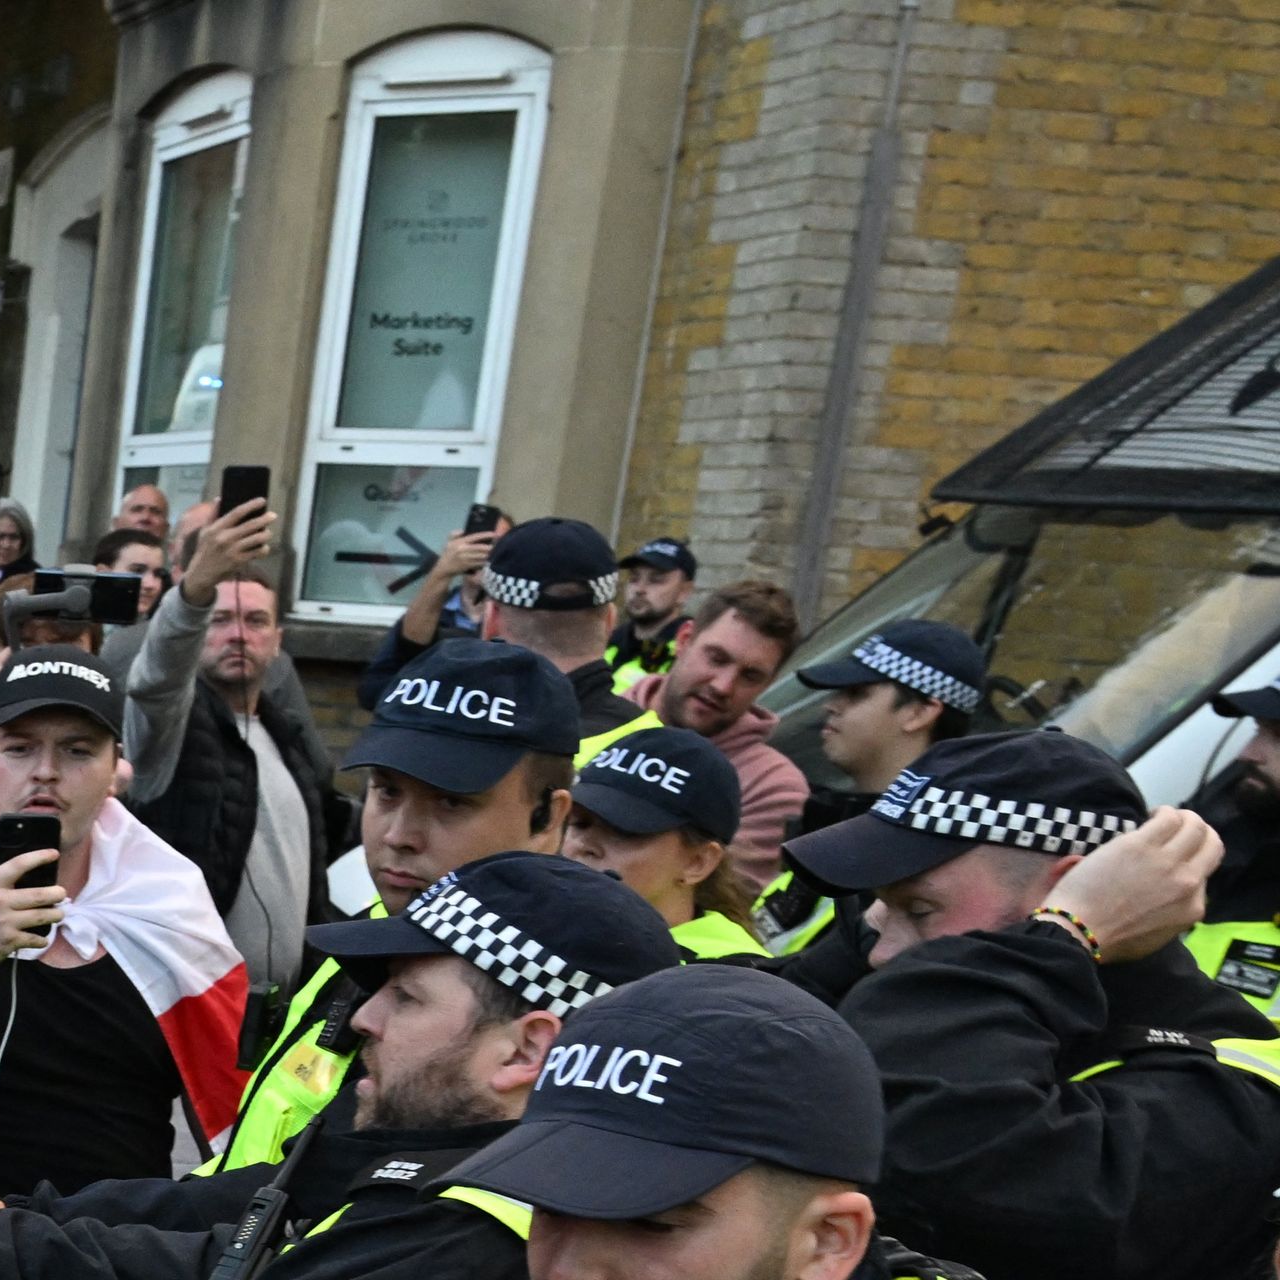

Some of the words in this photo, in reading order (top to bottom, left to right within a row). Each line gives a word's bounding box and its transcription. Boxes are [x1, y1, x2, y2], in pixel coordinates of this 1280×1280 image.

[370, 311, 475, 335] Marketing
[393, 337, 444, 357] Suite
[384, 677, 517, 728] POLICE
[586, 747, 690, 795] POLICE
[533, 1043, 684, 1105] POLICE
